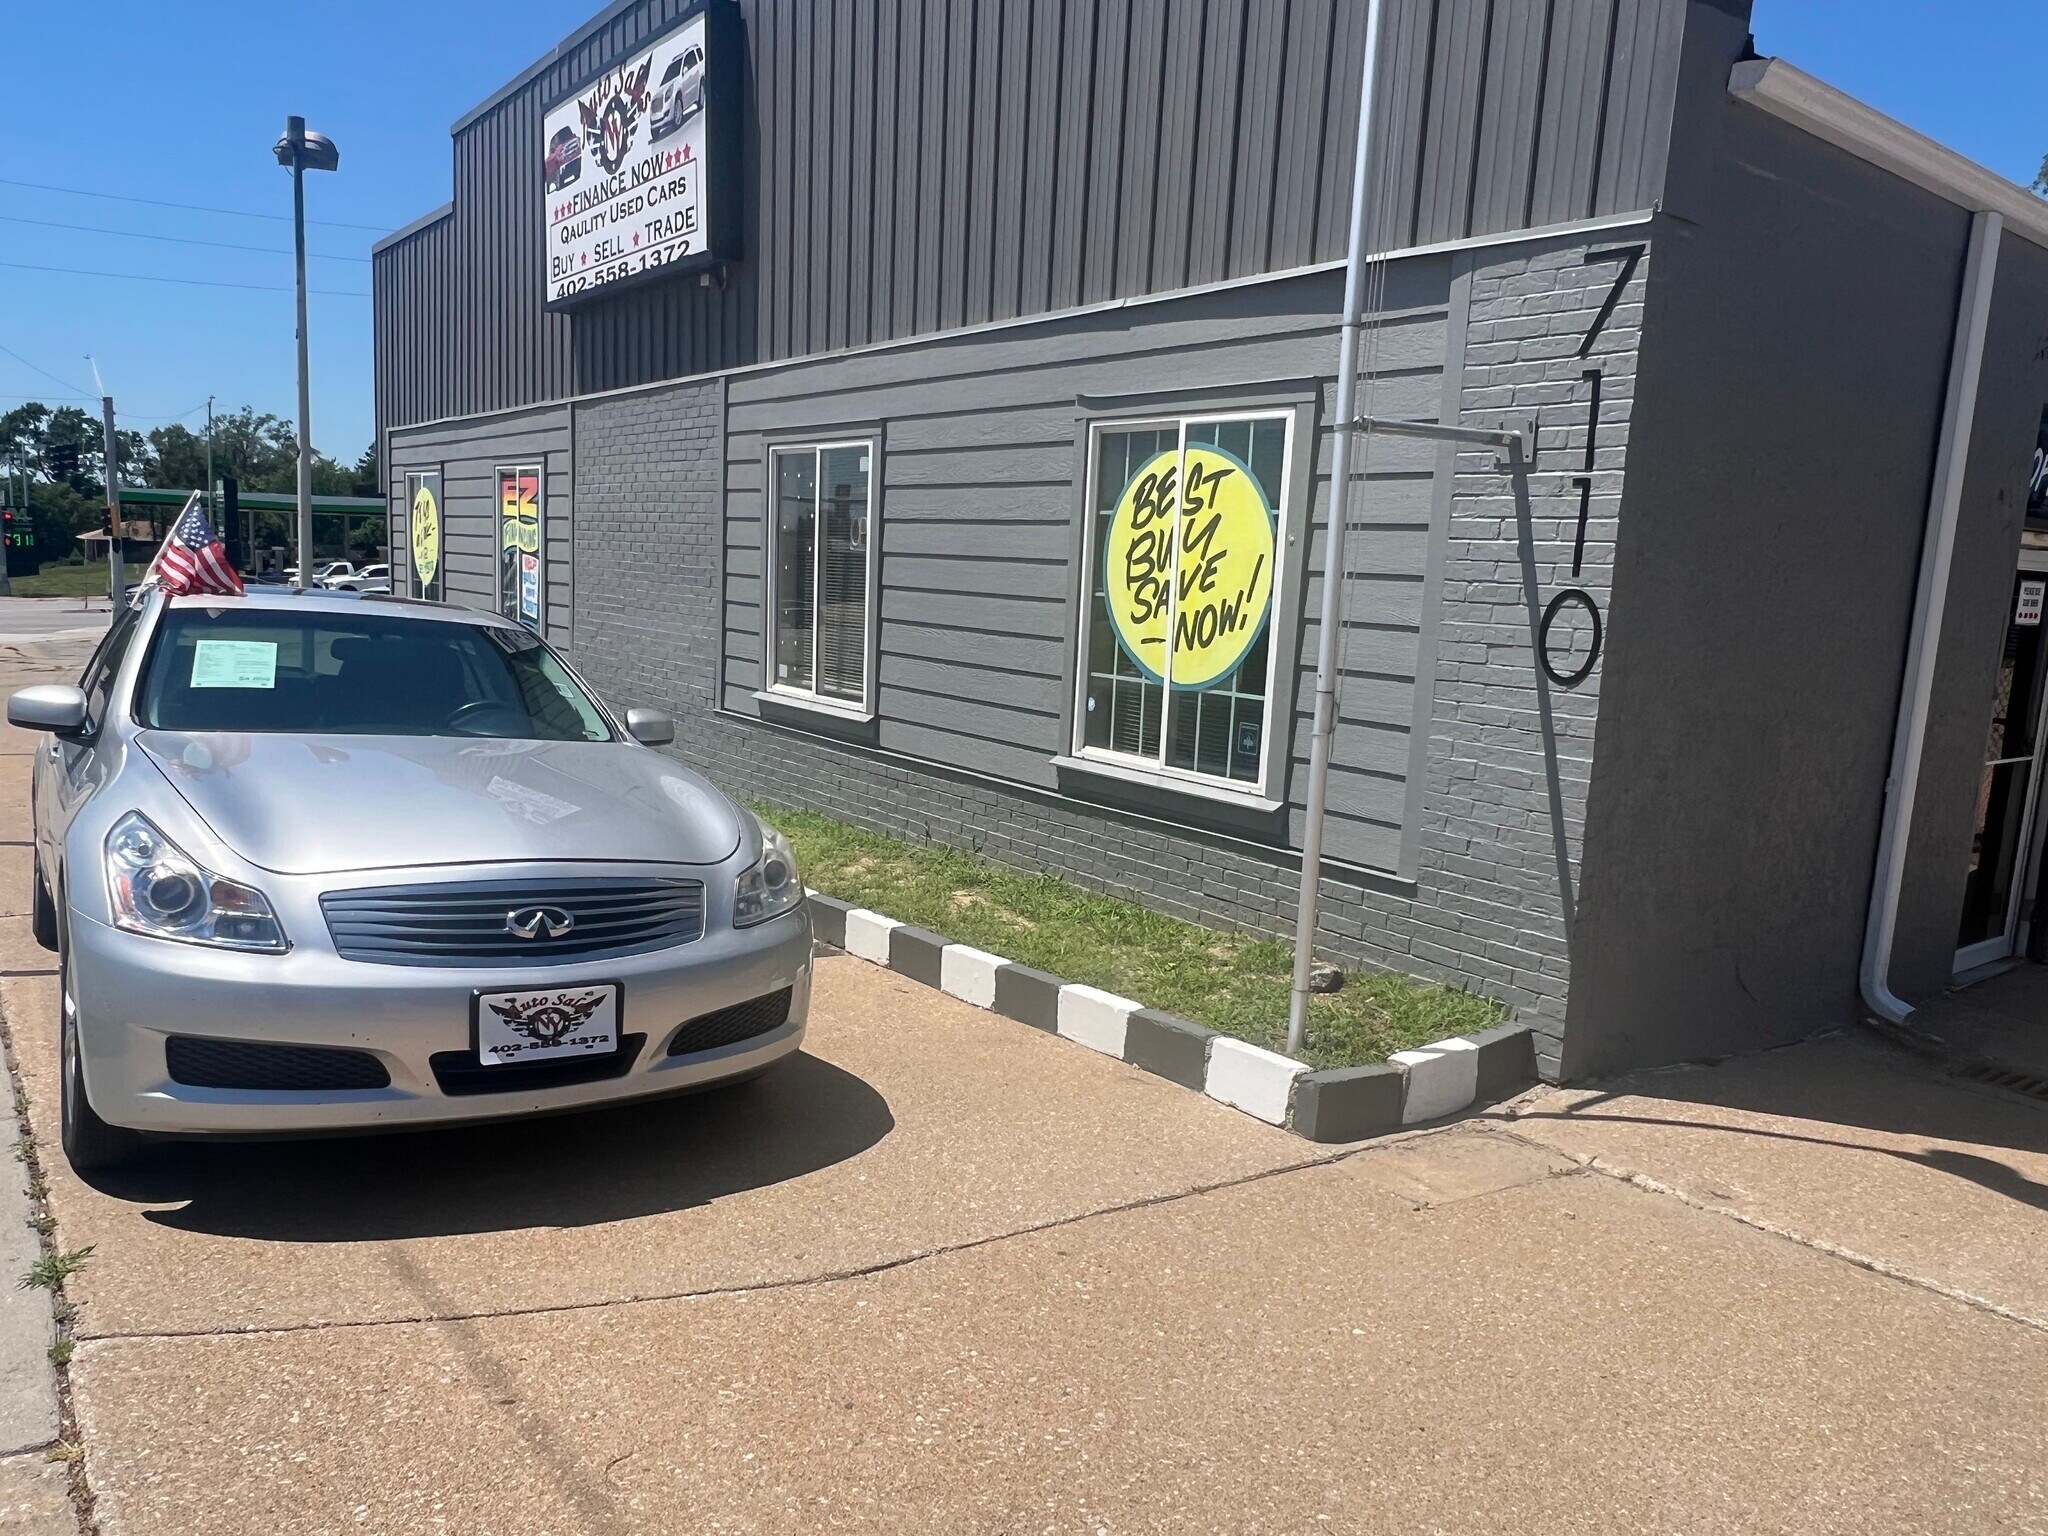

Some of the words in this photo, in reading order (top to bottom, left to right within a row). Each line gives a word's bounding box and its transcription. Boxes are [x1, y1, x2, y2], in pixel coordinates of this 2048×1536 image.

[573, 171, 627, 214] FINANCE
[631, 152, 664, 188] NOW
[553, 253, 575, 278] BUY
[594, 235, 625, 262] SELL
[645, 205, 695, 243] TRADE
[556, 240, 690, 298] 402-558-1372
[502, 476, 538, 519] EZ
[1130, 461, 1236, 531] BEST
[504, 522, 537, 548] FINNCING
[1126, 512, 1222, 591] BUY
[1130, 549, 1227, 625] SAVE
[1173, 553, 1265, 653] NOW!
